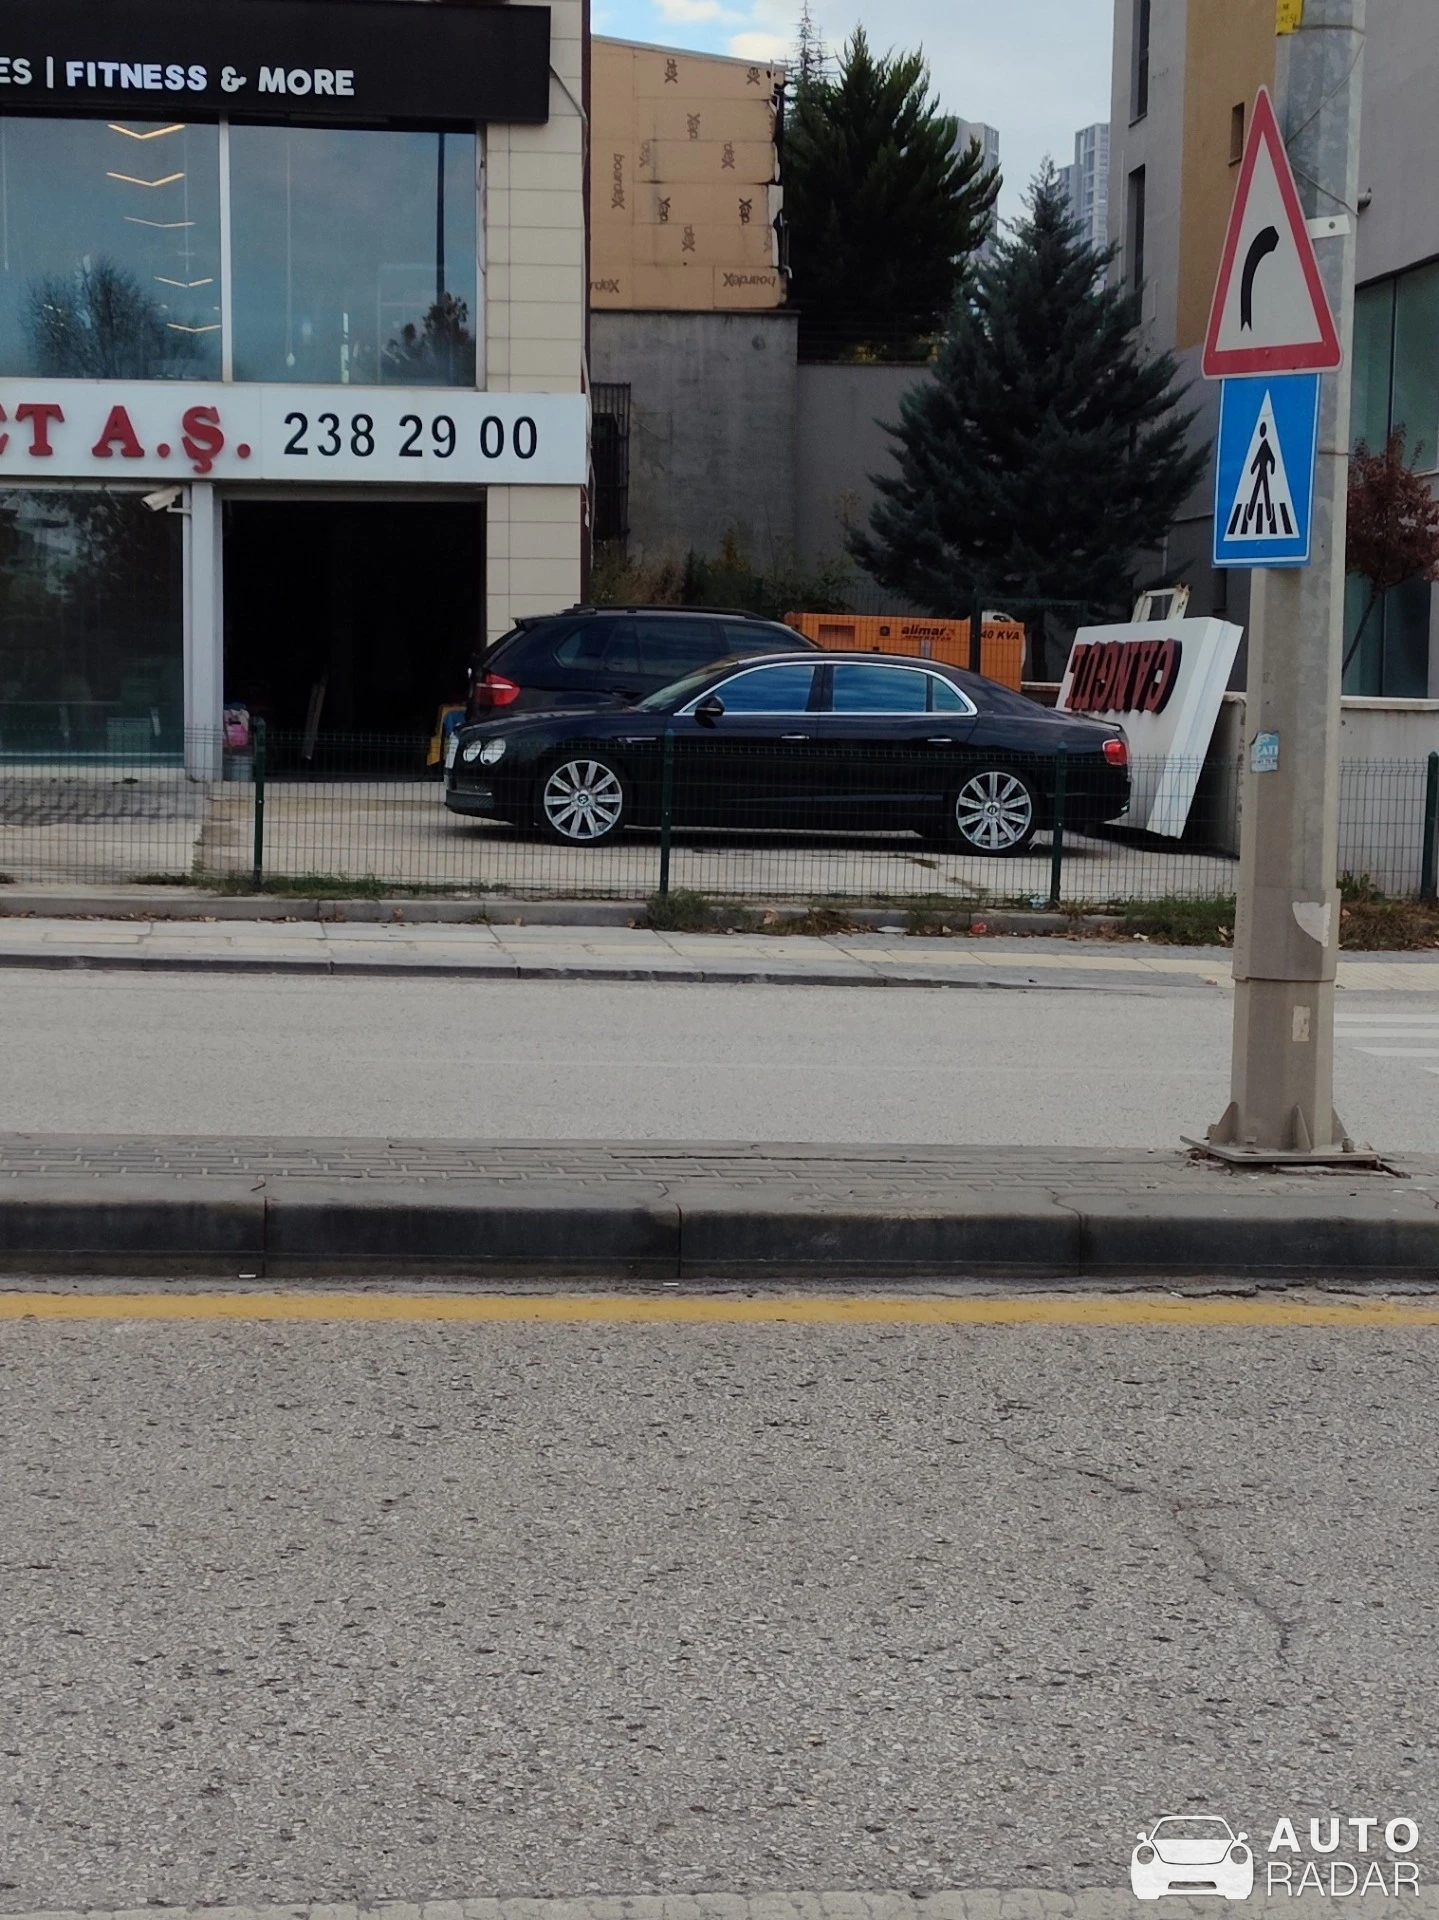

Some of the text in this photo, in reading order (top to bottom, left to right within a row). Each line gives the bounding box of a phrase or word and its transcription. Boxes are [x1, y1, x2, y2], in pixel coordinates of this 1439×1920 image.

[0, 57, 32, 85] ES
[66, 61, 207, 91] FITNESS
[220, 67, 247, 92] &
[258, 67, 355, 96] MORE
[92, 405, 252, 474] A.Ş.
[284, 412, 538, 460] 238 29 00
[996, 630, 1020, 641] KVA
